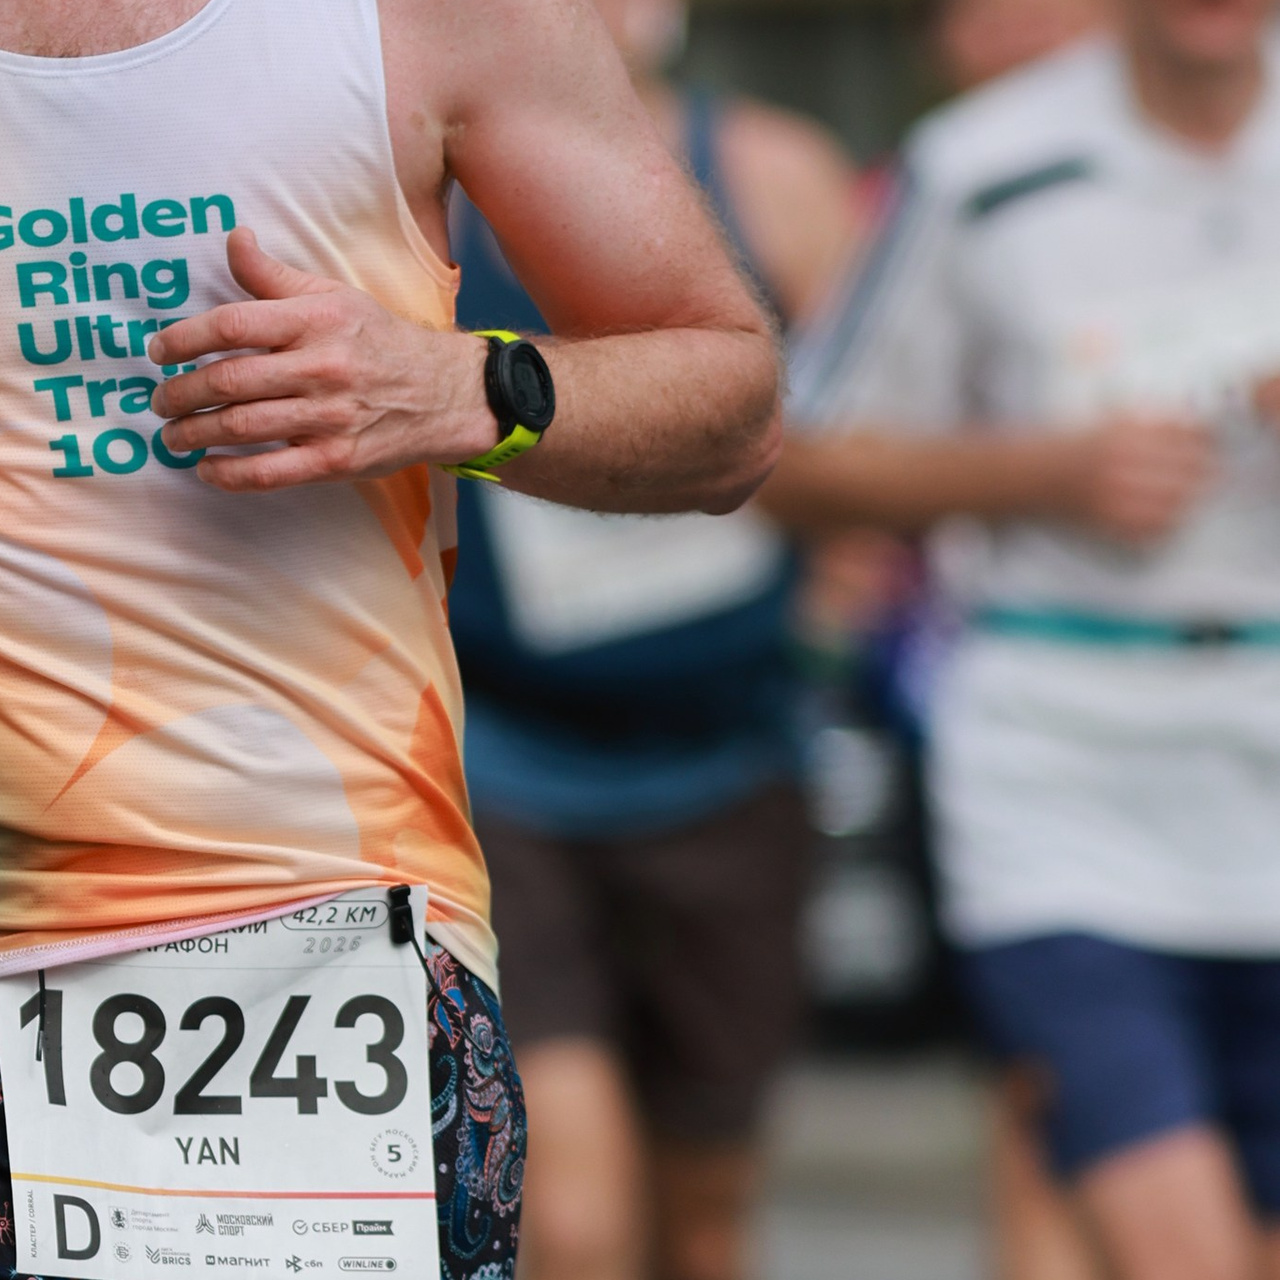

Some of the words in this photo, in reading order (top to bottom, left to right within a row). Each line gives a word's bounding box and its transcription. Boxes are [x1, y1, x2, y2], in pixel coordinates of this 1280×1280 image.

[16, 251, 190, 309] Ring
[17, 314, 188, 366] Ultr
[33, 363, 197, 422] Tra
[292, 906, 336, 926] 42,2
[19, 989, 409, 1116] 18243
[175, 1136, 240, 1166] YAN
[387, 1144, 402, 1163] 5
[53, 1193, 101, 1261] D
[216, 1213, 274, 1226] МОСКОВСКИЙ
[312, 1222, 349, 1233] СБЕР
[356, 1223, 387, 1233] Прайм
[218, 1225, 245, 1236] СПОРТ
[162, 1256, 192, 1266] BRICS
[342, 1260, 384, 1269] WINLINE
